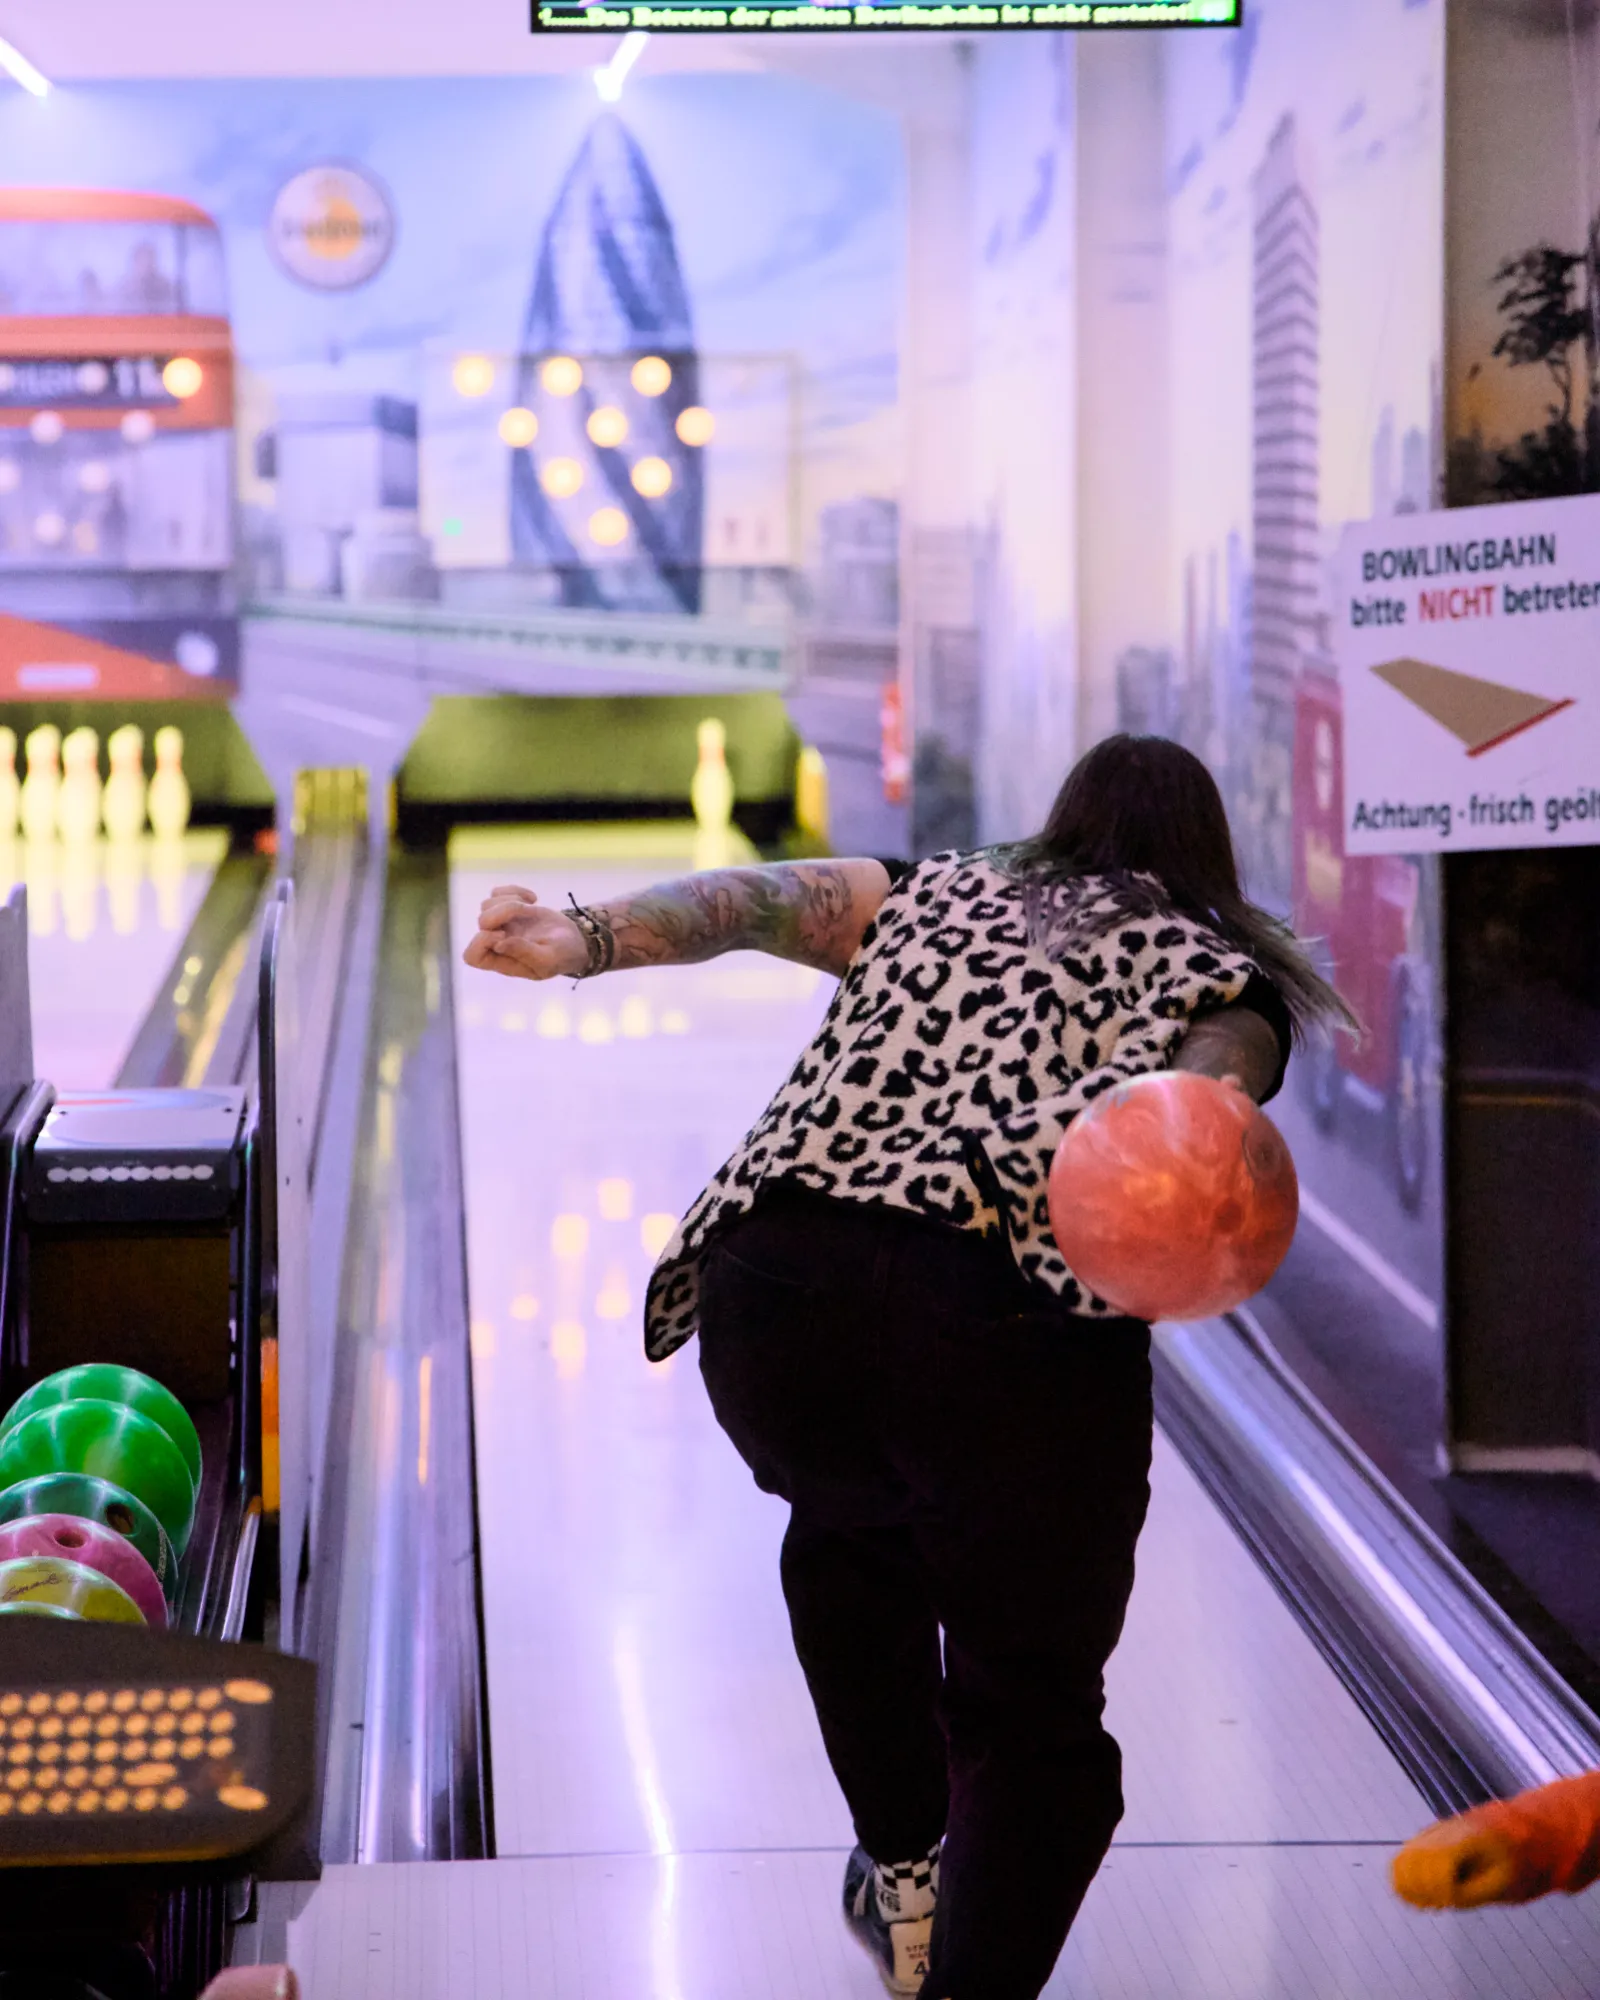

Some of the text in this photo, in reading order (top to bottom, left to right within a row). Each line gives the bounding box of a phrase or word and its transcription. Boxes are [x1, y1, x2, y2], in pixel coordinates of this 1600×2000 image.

[1362, 534, 1556, 582] BOWLINGBAHN
[1350, 597, 1407, 627] bitte
[1418, 585, 1495, 621] NICHT
[1352, 801, 1452, 836] Achtung
[1468, 793, 1536, 826] frisch
